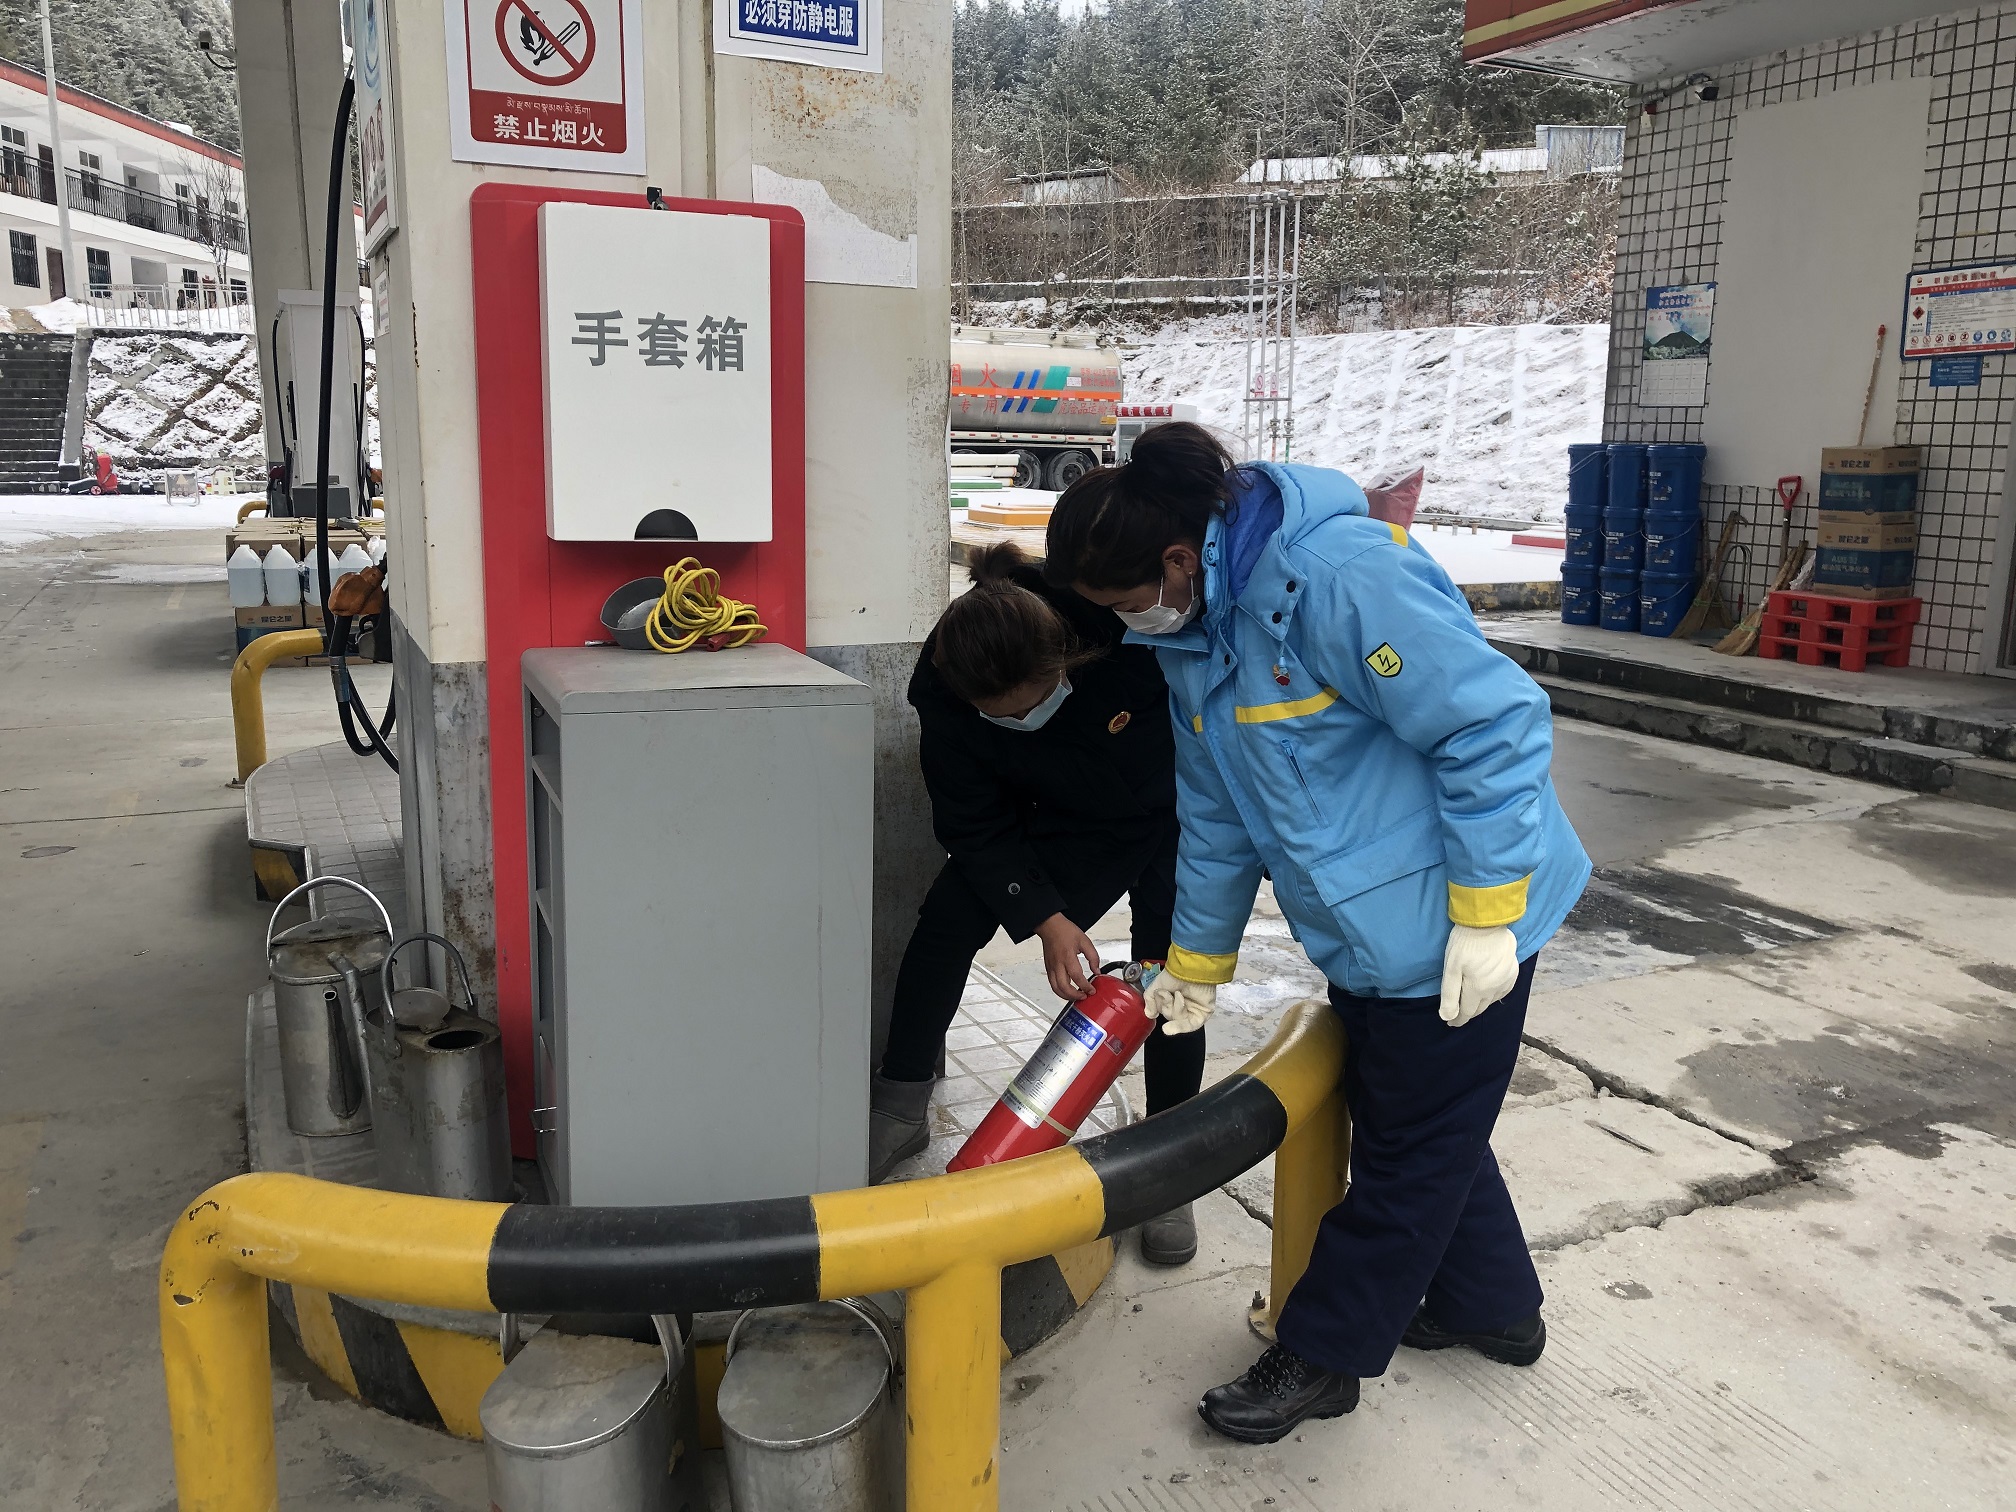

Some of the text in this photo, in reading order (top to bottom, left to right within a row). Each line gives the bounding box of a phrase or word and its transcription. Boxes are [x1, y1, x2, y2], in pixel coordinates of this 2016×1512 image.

[745, 0, 854, 38] 必须穿防静电服
[493, 113, 606, 147] 禁止烟火
[571, 309, 748, 372] 手套箱
